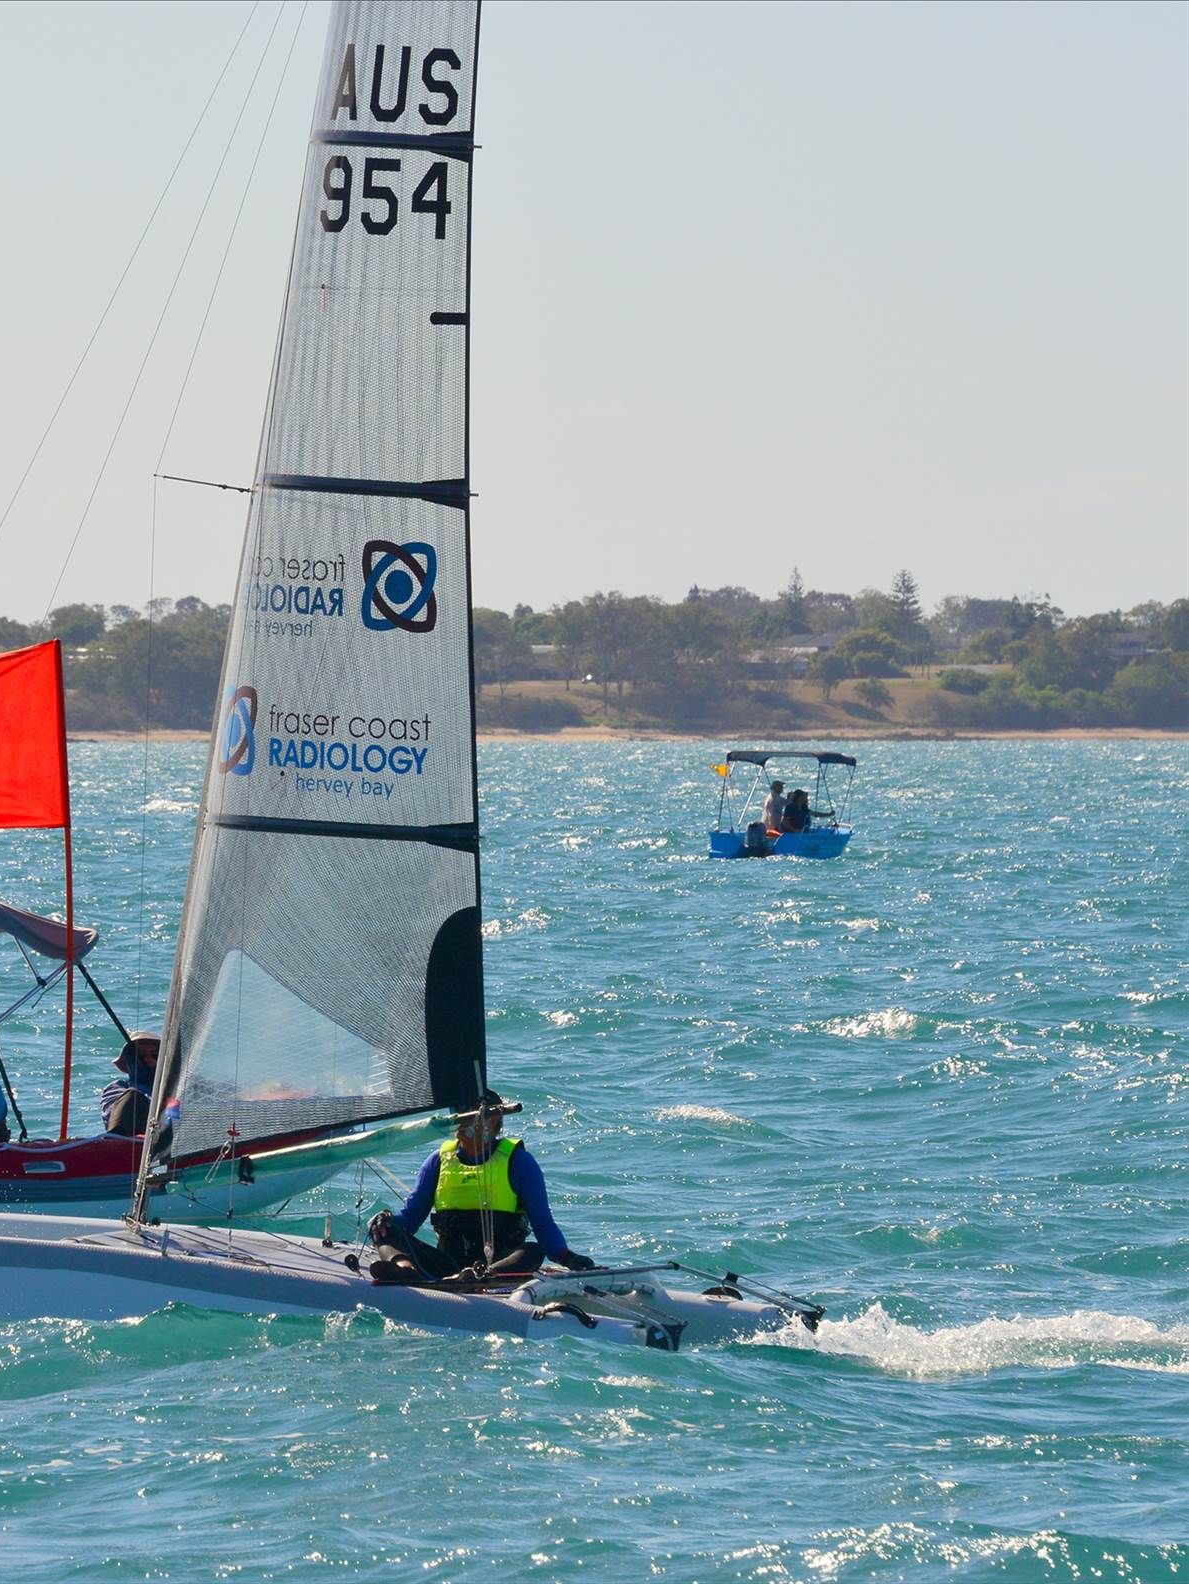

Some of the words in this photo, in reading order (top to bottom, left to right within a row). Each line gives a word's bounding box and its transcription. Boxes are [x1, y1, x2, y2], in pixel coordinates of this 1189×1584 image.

[330, 43, 461, 126] AUS
[320, 155, 452, 240] 954
[269, 704, 340, 736] fraser
[348, 713, 432, 741] coast
[268, 737, 428, 774] RADIOLOGY
[295, 773, 354, 798] hervey
[361, 777, 394, 800] bay
